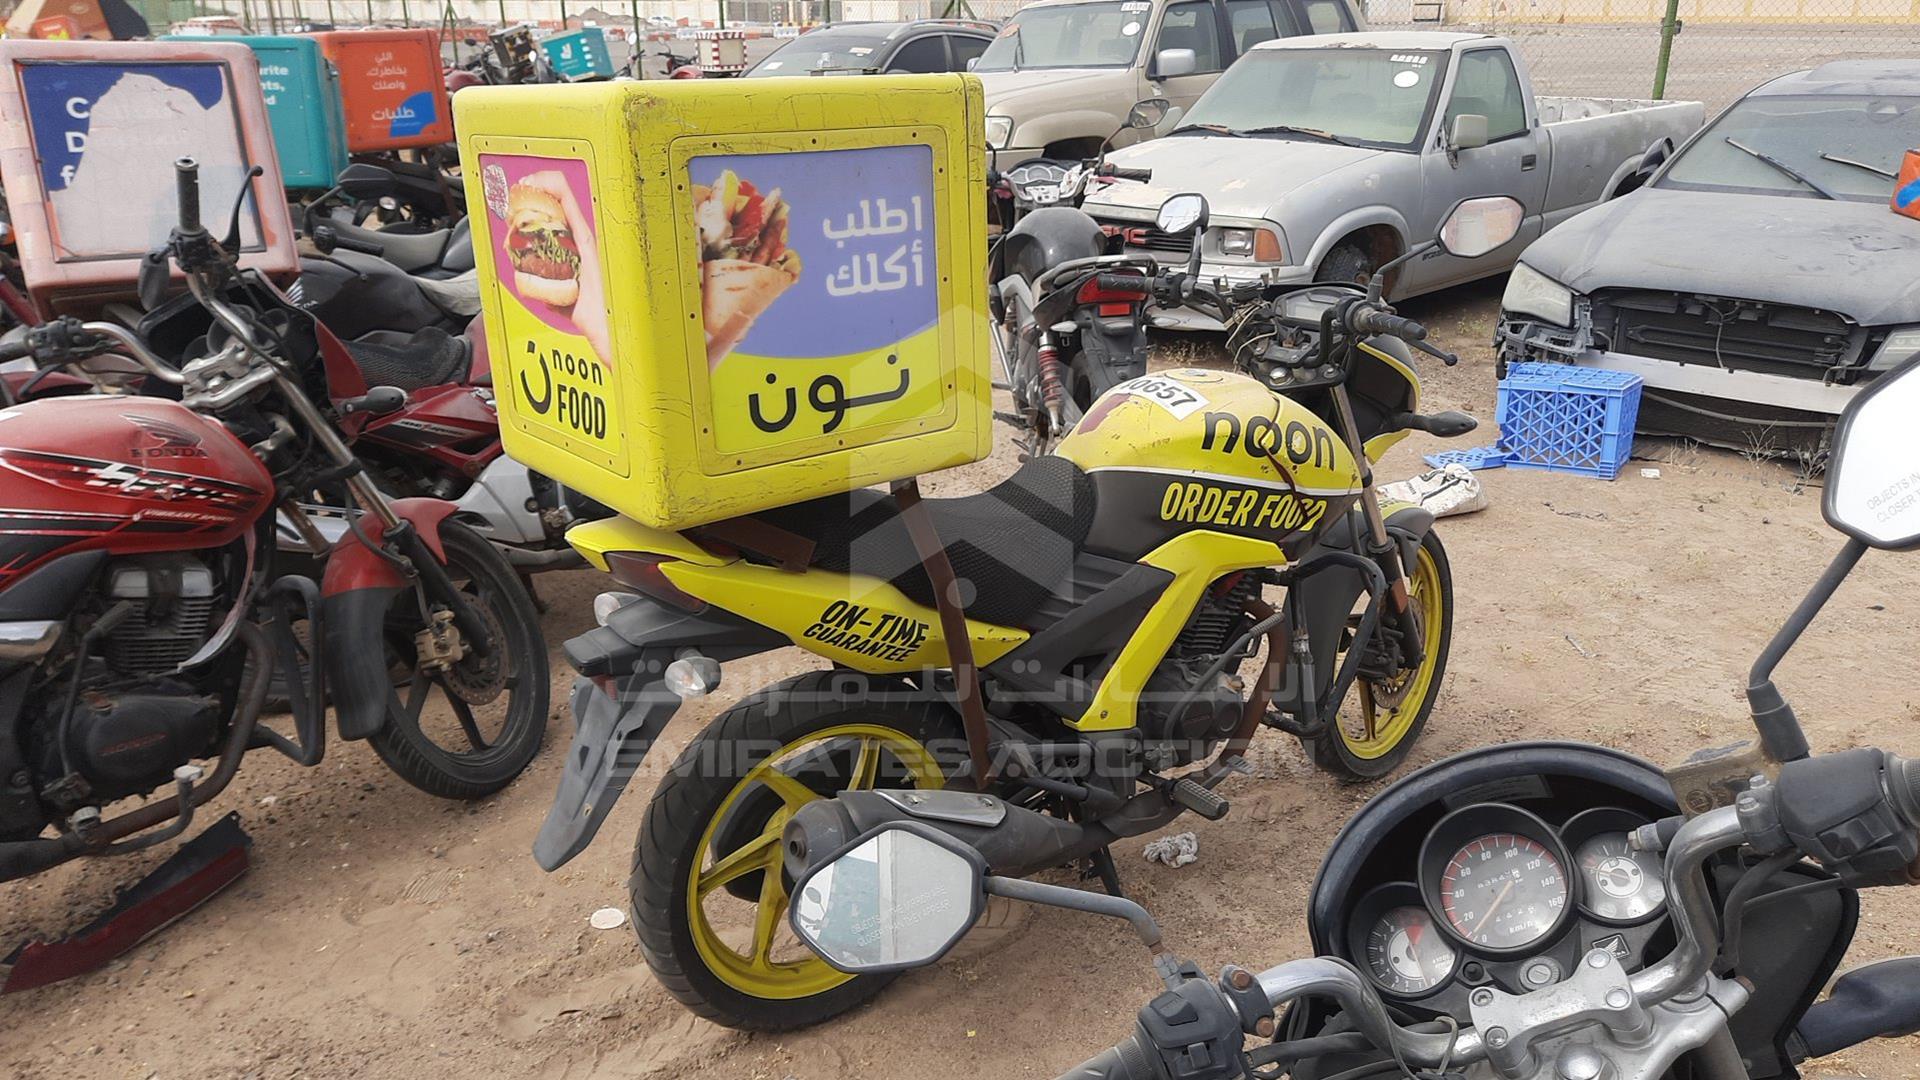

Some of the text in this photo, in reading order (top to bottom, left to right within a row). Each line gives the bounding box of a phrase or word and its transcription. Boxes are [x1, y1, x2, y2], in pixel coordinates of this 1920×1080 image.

[374, 51, 393, 66] اللي
[372, 80, 406, 91] واصلك
[371, 106, 415, 123] طلبات
[822, 195, 922, 248] اطلب
[826, 239, 923, 297] أكلك
[552, 349, 602, 386] noon
[748, 354, 910, 434] نون
[557, 384, 606, 440] FOOD
[1201, 411, 1335, 471] noon
[130, 447, 208, 458] HONDA
[1866, 478, 1910, 510] OBJECTS
[1161, 482, 1259, 527] ORDER
[1876, 494, 1917, 523] CLOSER
[820, 600, 930, 648] ON-TIME
[803, 623, 917, 662] GUARANTEE
[1481, 851, 1492, 861] 80
[1504, 848, 1518, 859] 100
[1460, 867, 1471, 877] 60
[1526, 859, 1540, 870] 120
[1541, 876, 1555, 888] 140
[1454, 889, 1465, 899] 40
[1548, 896, 1563, 908] 160
[1464, 911, 1474, 922] 20
[1481, 934, 1488, 943] 0
